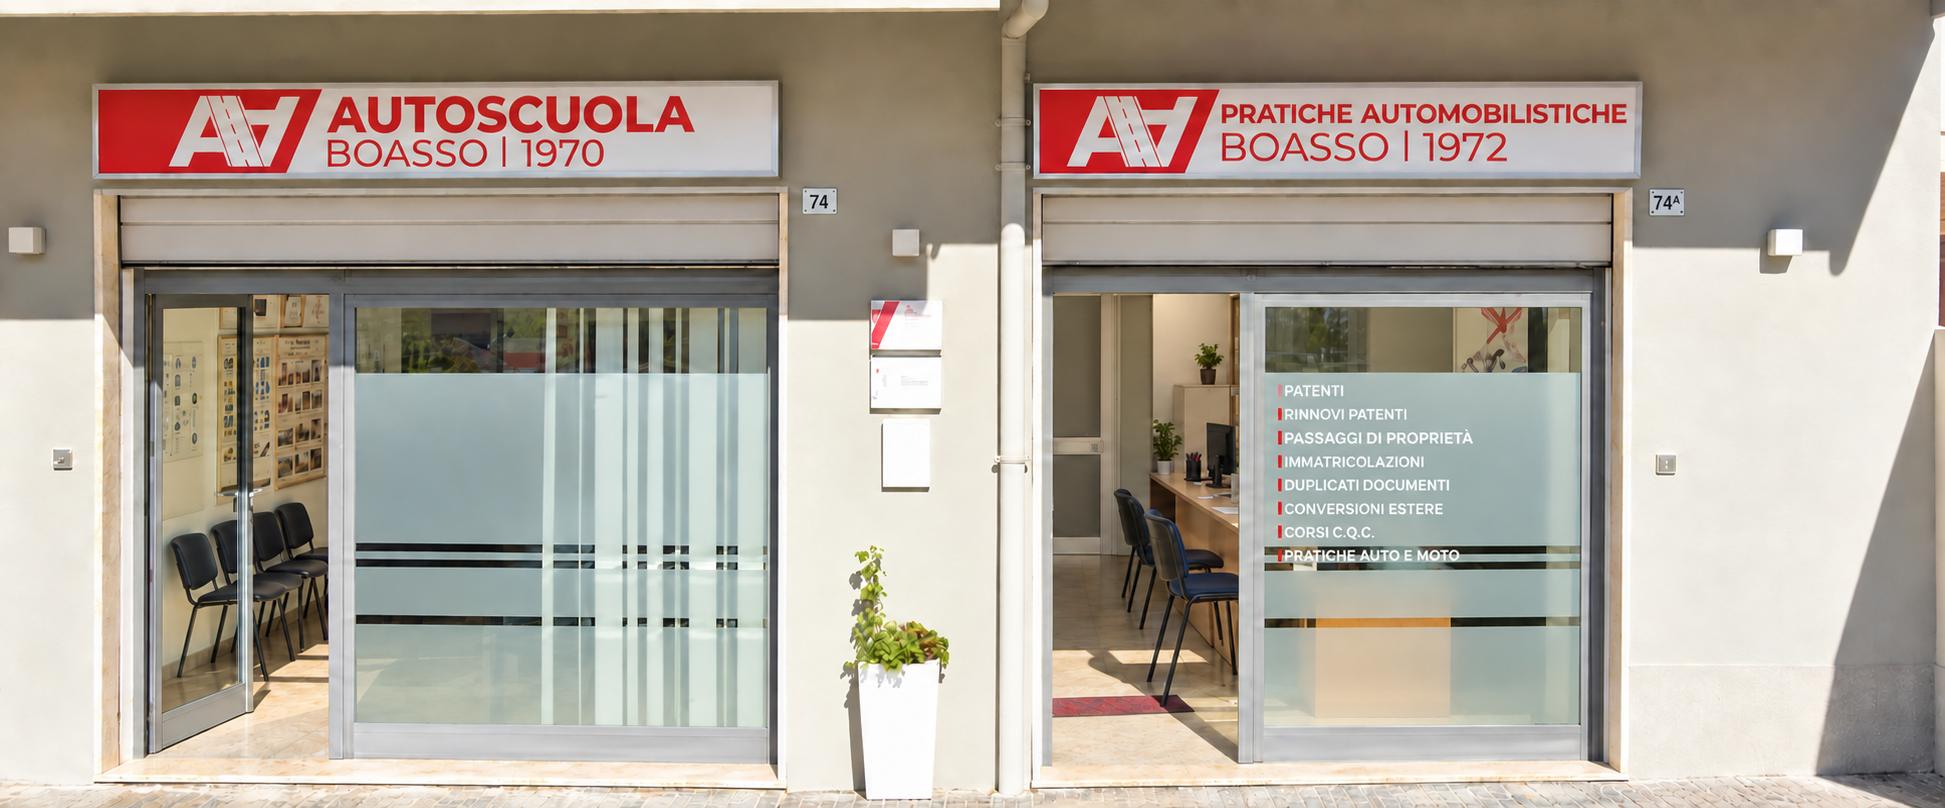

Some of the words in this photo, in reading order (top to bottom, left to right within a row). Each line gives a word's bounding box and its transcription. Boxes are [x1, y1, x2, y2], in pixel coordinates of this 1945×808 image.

[327, 95, 696, 134] AUTOSCUOLA
[1221, 103, 1353, 124] PRATICHE
[1360, 103, 1628, 124] AUTOMOBILISTICHE
[327, 138, 488, 168] BOASSO
[520, 138, 605, 168] 1970
[1221, 131, 1389, 162] BOASSO
[1422, 131, 1508, 162] 1972
[809, 194, 829, 210] 74
[1284, 384, 1344, 397] PATENTI
[1284, 408, 1345, 421] RINNOVI
[1348, 408, 1407, 421] PATENTI
[1284, 431, 1362, 445] PASSAGGI
[1366, 432, 1382, 445] DI
[1386, 428, 1474, 445] PROPRIETÀ
[1284, 455, 1424, 468] IMMATRICOLAZIONI
[1284, 479, 1359, 491] DUPLICATI
[1363, 478, 1450, 491] DOCUMENTI
[1284, 502, 1384, 515] CONVERSIONI
[1388, 502, 1444, 515] ESTERE
[1284, 526, 1329, 539] CORSI
[1332, 526, 1375, 540] C.Q.C.
[1284, 549, 1356, 562] PRATICHE
[1359, 549, 1400, 562] AUTO
[1404, 549, 1413, 562] E
[1417, 549, 1460, 562] MOTO
